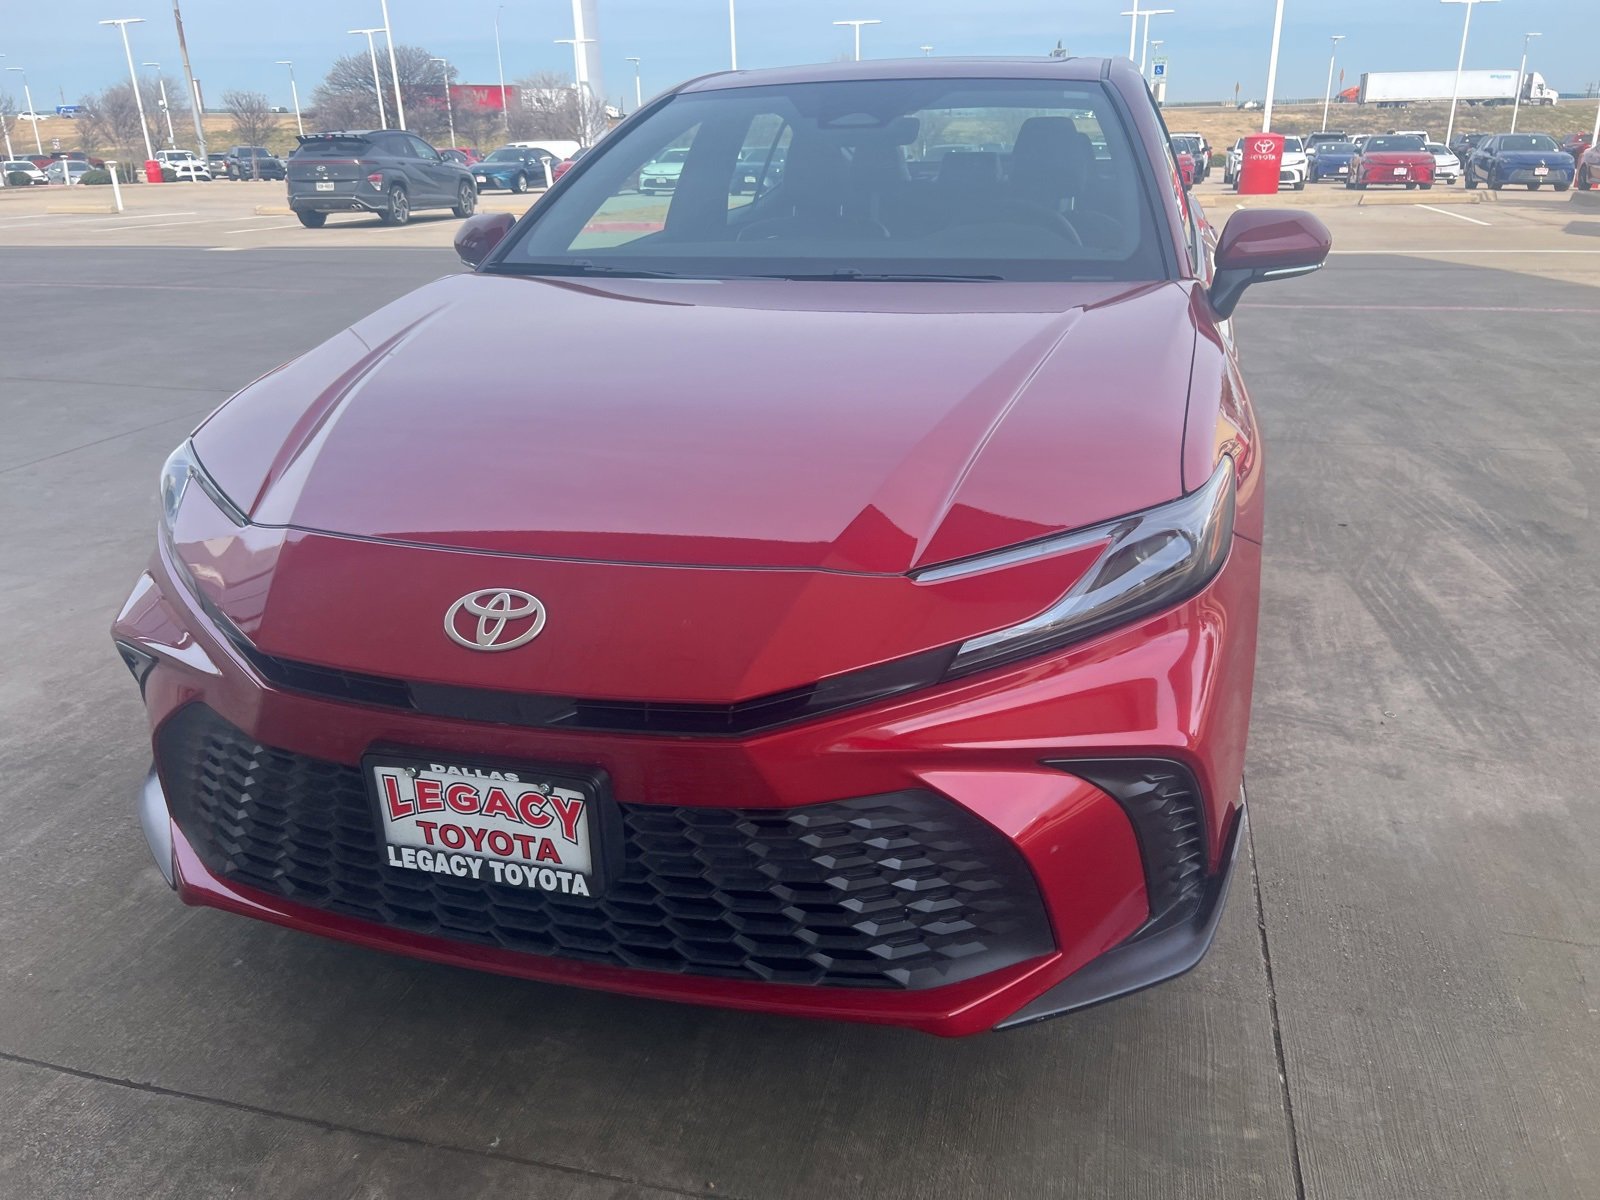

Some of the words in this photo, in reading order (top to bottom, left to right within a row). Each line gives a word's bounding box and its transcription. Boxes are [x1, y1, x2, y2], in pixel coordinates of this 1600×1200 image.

[429, 763, 520, 783] DALLAS
[382, 774, 586, 845] LEGACY
[415, 820, 563, 865] TOYOTA
[387, 845, 483, 879] LEGACY
[489, 860, 590, 897] TOYOTA
